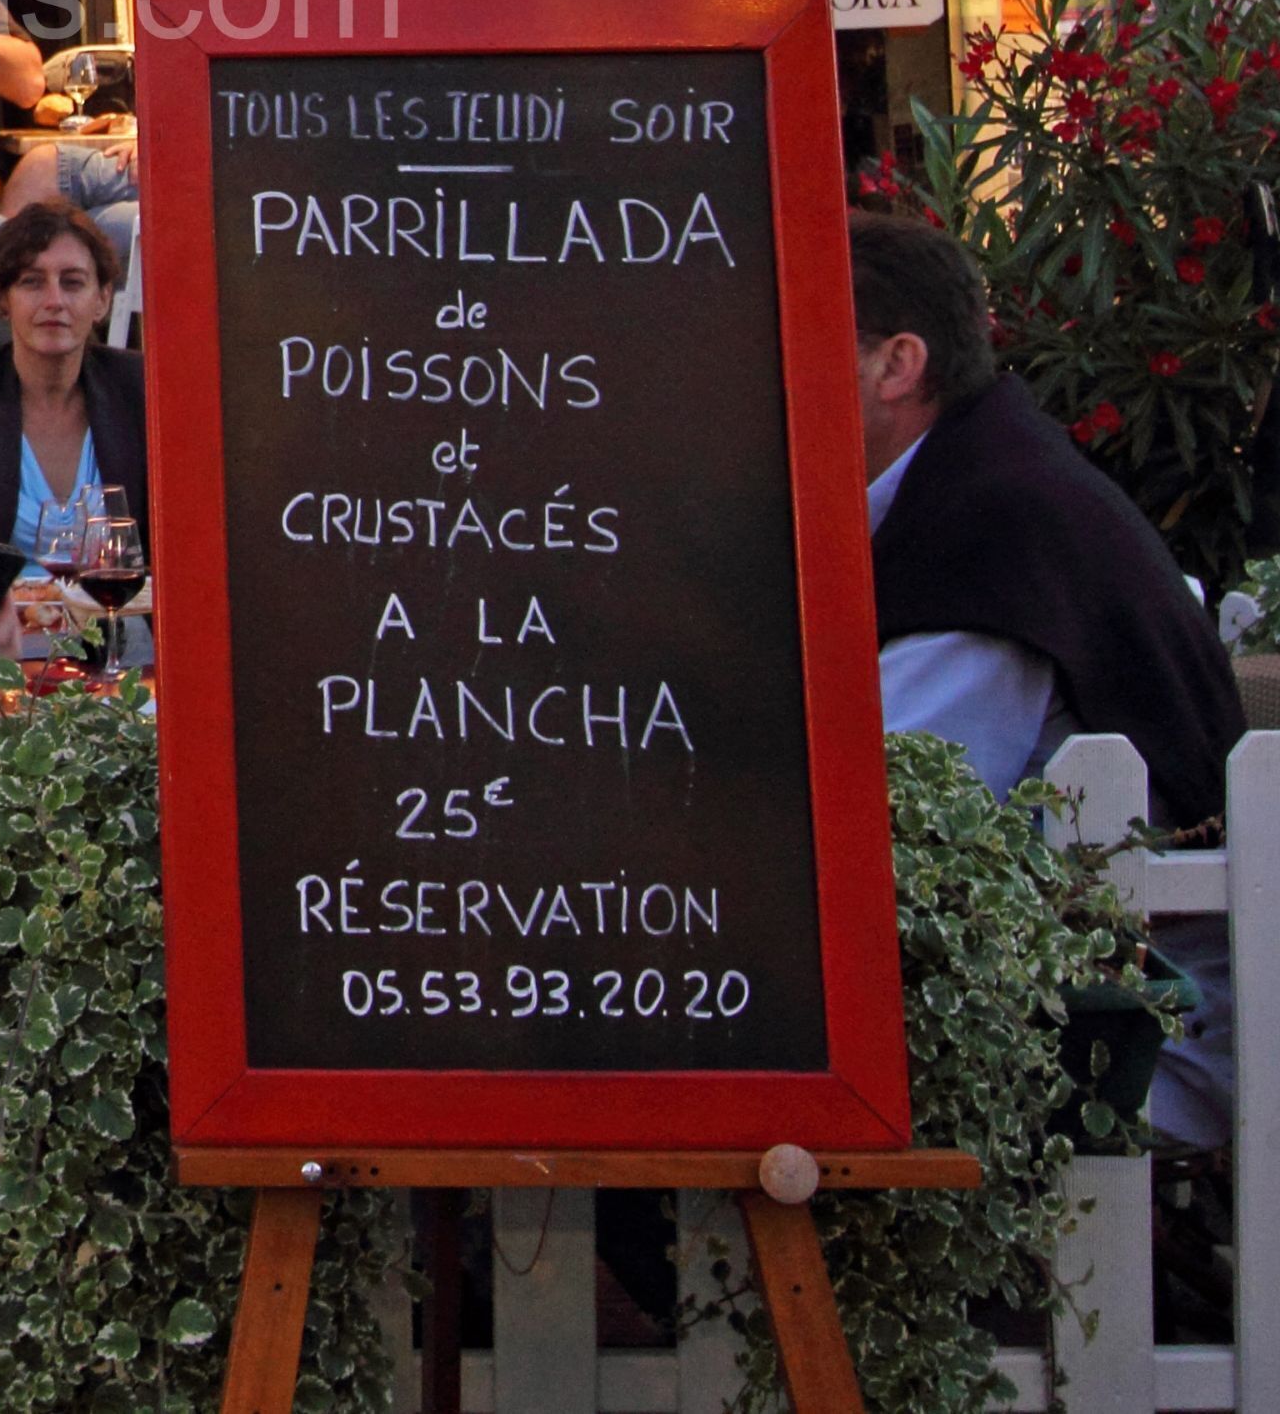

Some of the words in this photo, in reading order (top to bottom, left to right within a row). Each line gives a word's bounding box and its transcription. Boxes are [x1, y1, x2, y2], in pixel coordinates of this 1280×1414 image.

[218, 89, 330, 142] TOUS
[349, 90, 429, 141] LES
[436, 88, 566, 143] JEUDI
[610, 88, 735, 143] SOIR
[252, 187, 736, 267] PARRILLADA
[435, 289, 489, 330] de
[279, 336, 601, 410] POISSONS
[431, 427, 480, 473] et
[281, 483, 620, 553] CRUSTACÉS
[376, 593, 415, 641] A
[478, 596, 556, 644] LA
[316, 674, 694, 752] PLANCHA
[395, 776, 515, 840] 25€
[295, 858, 719, 937] RÉSERVATION
[342, 964, 750, 1019] 05.53.93.20.20
